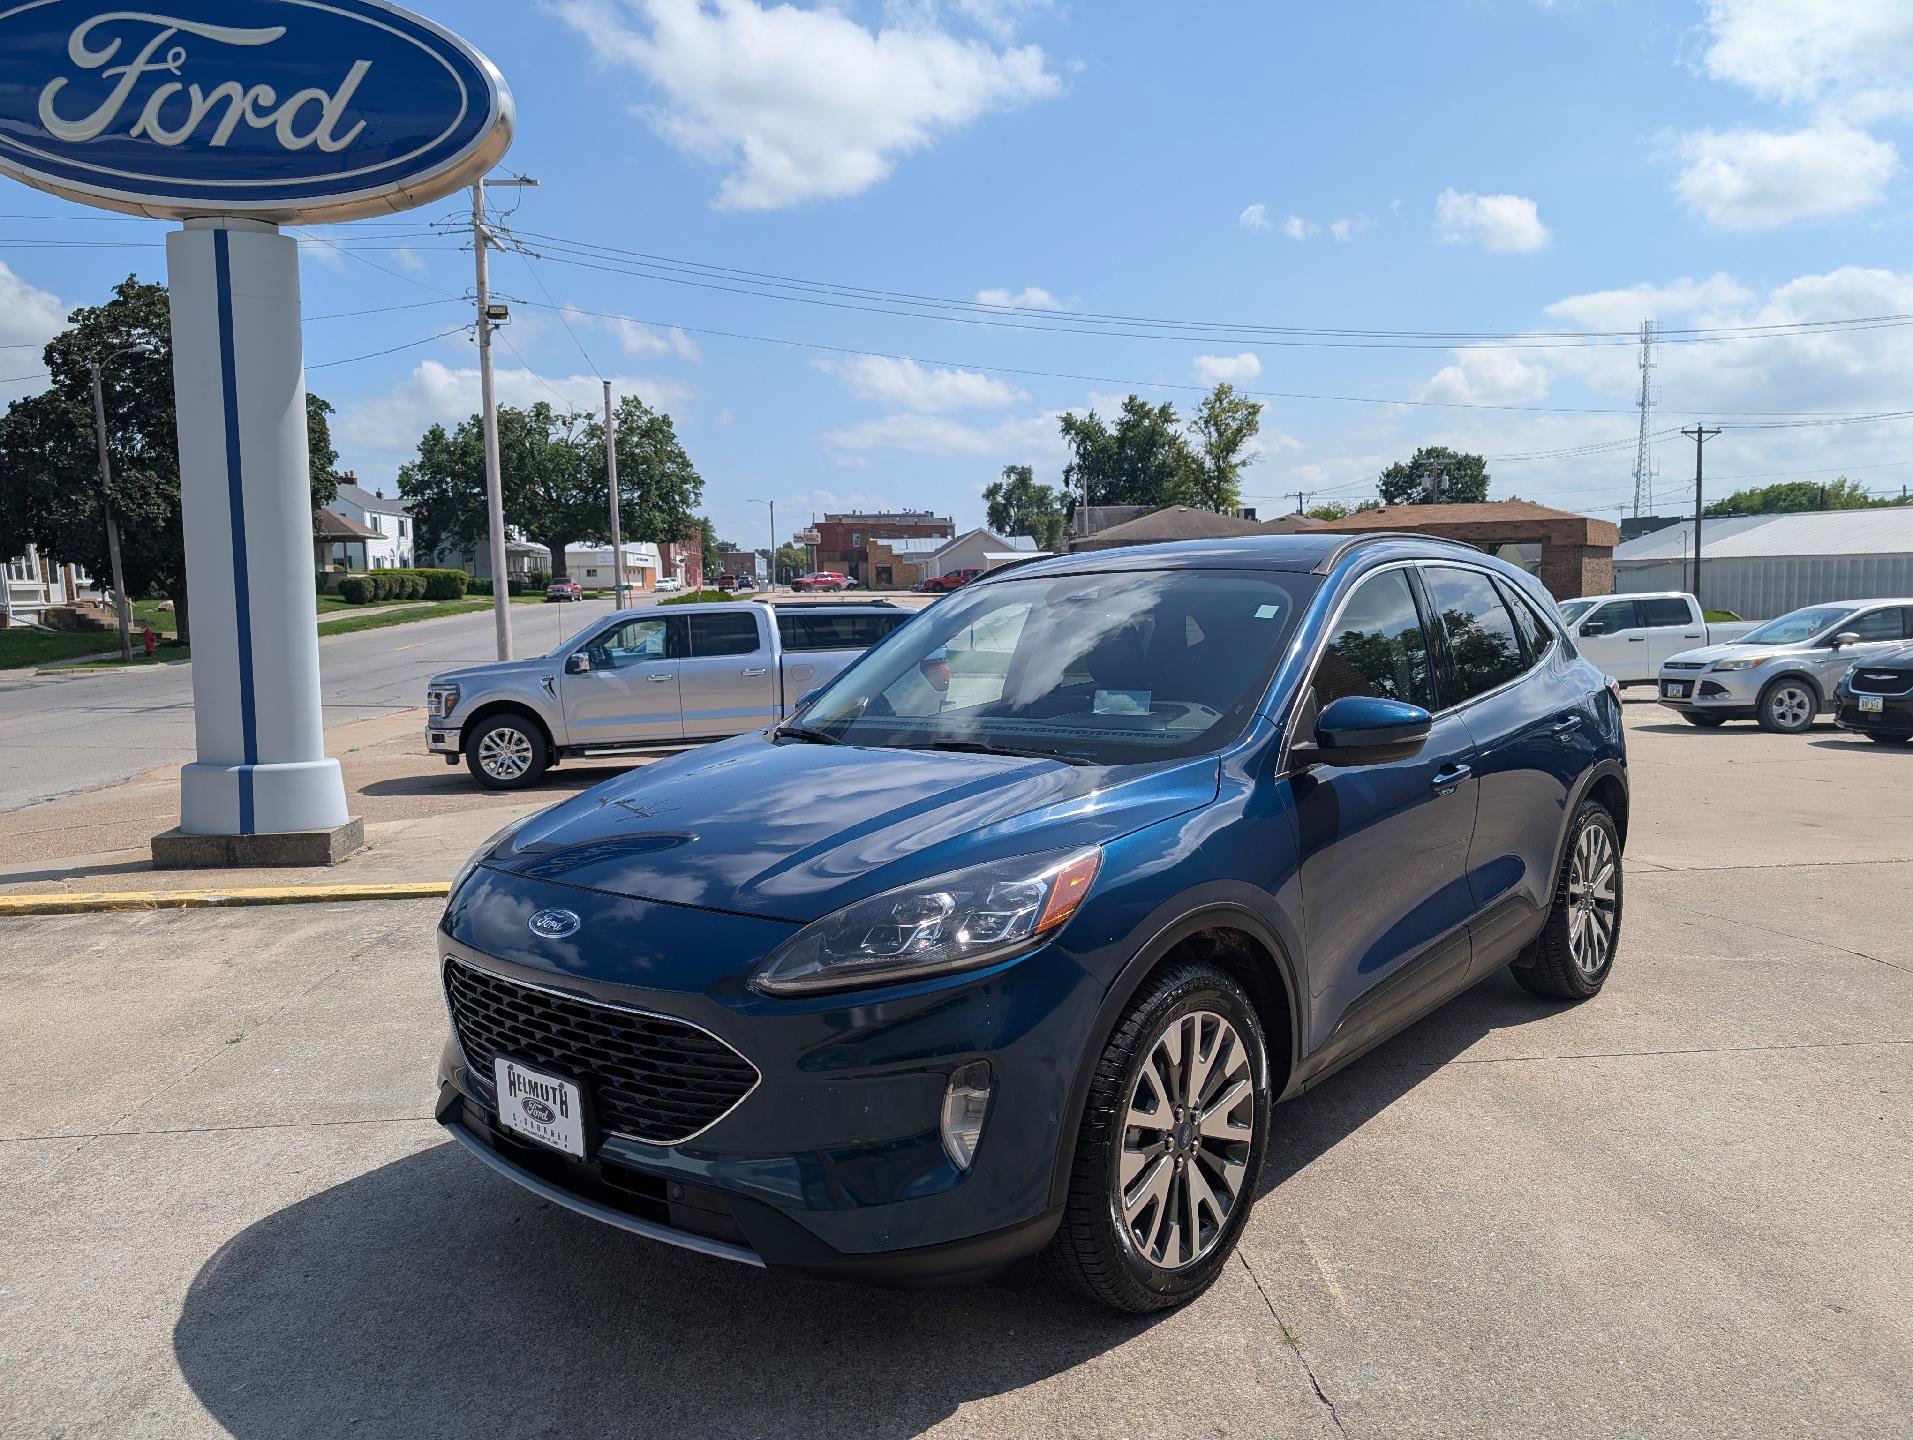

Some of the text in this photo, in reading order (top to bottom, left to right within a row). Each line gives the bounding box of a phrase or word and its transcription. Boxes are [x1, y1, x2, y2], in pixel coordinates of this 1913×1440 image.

[38, 11, 373, 153] Ford
[536, 912, 568, 931] Ford
[507, 1070, 569, 1119] HELMUTH
[526, 1100, 549, 1121] Ford
